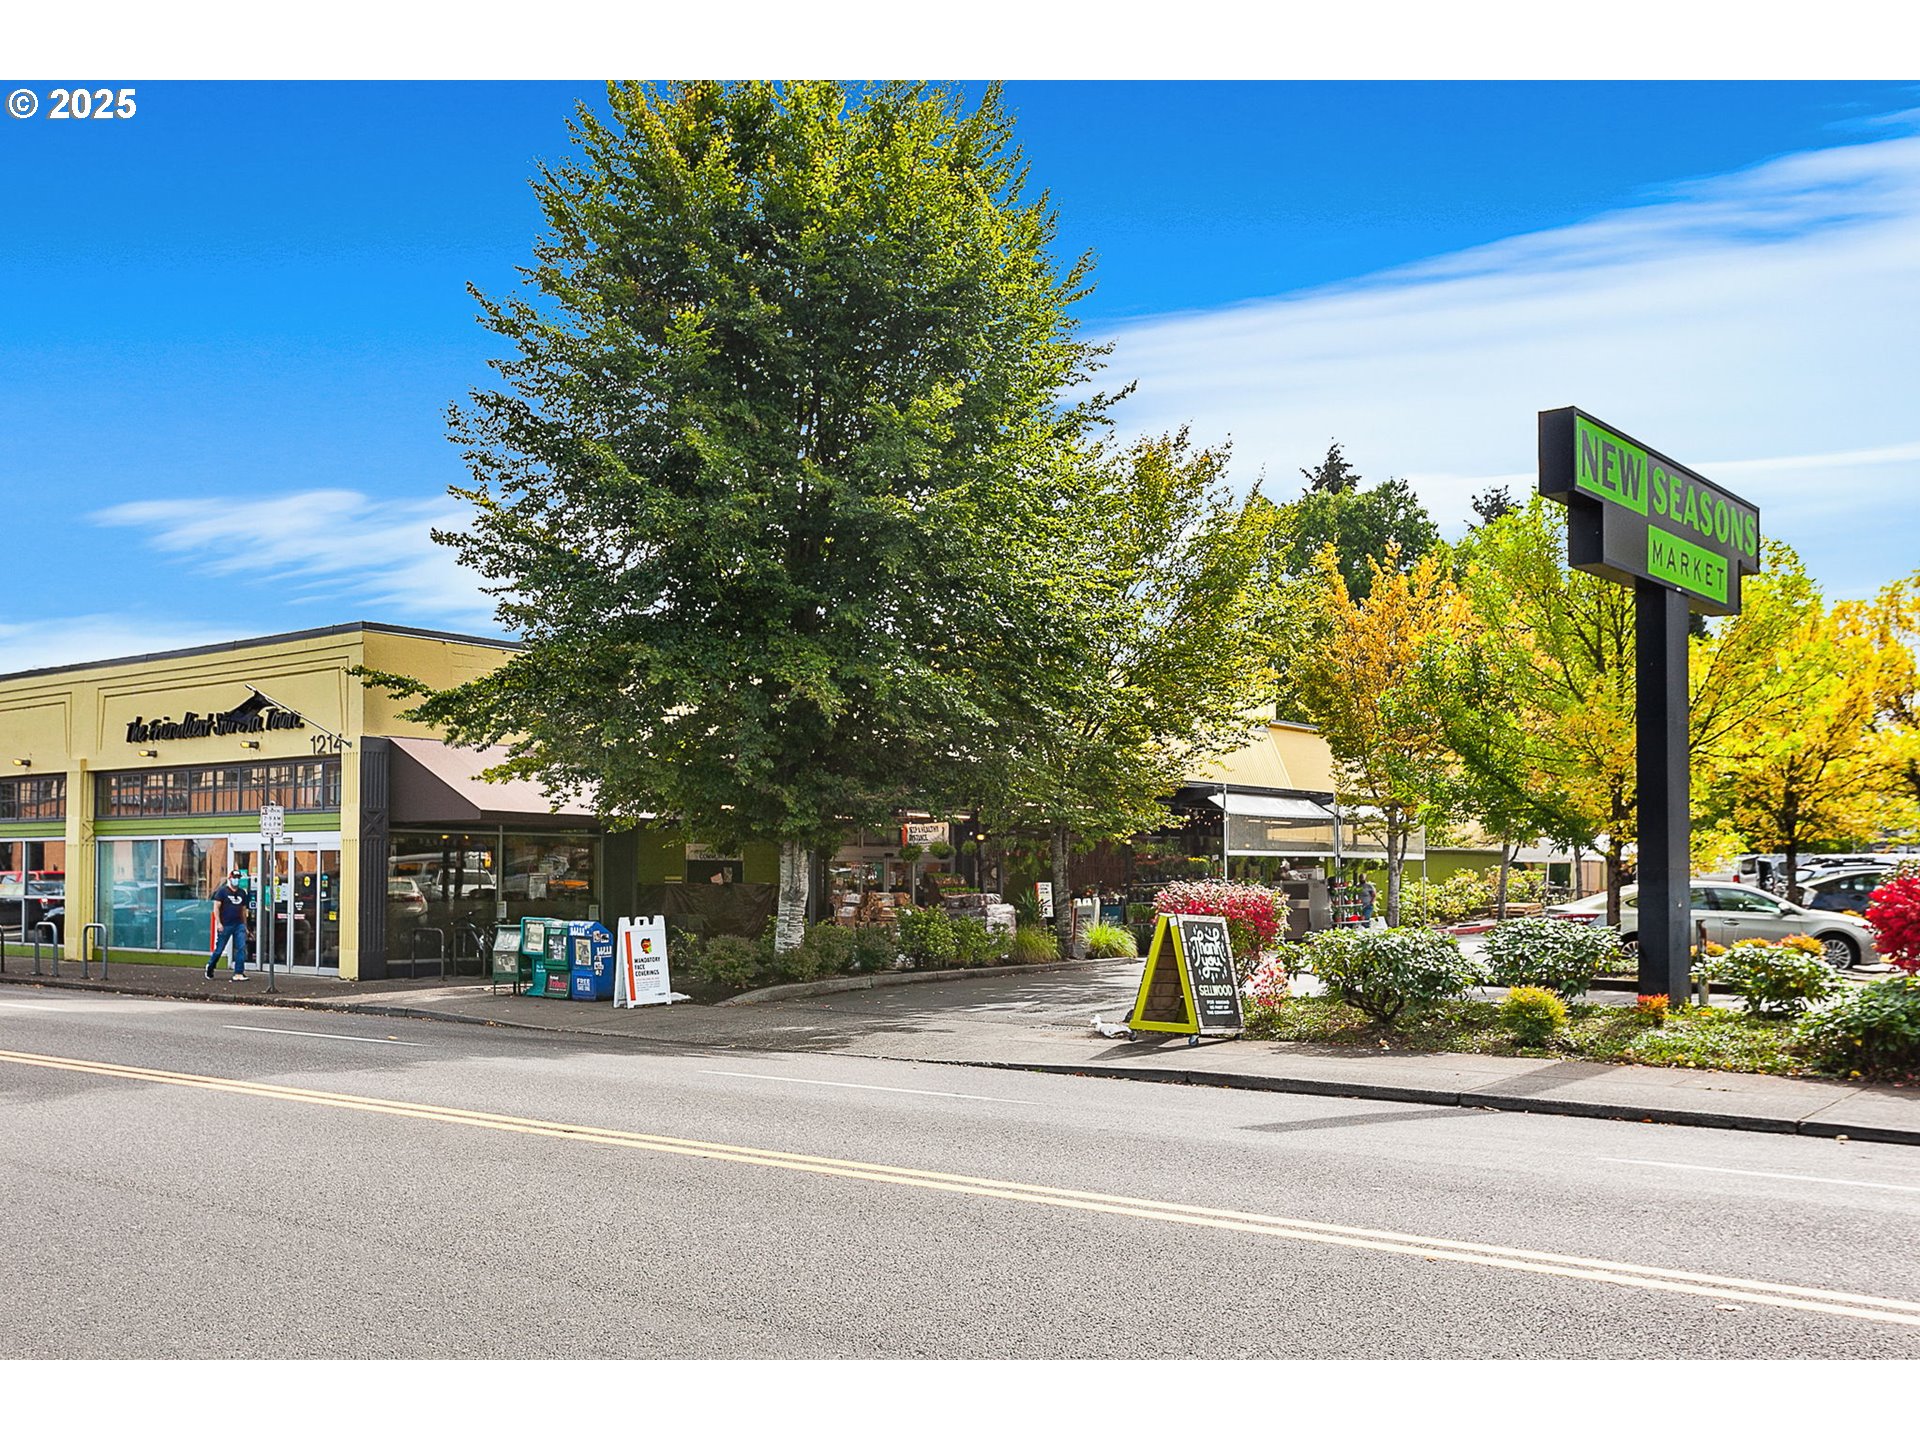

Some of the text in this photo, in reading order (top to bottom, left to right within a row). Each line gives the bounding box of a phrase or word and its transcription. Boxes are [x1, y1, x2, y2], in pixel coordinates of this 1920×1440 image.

[1582, 428, 1756, 557] NEW SEASONS
[1652, 540, 1724, 591] MARKET
[310, 733, 342, 754] 1214
[1190, 928, 1226, 967] Thank
[635, 969, 660, 977] COVERINGS
[1201, 955, 1223, 978] you
[1199, 984, 1233, 997] SELLWOOD
